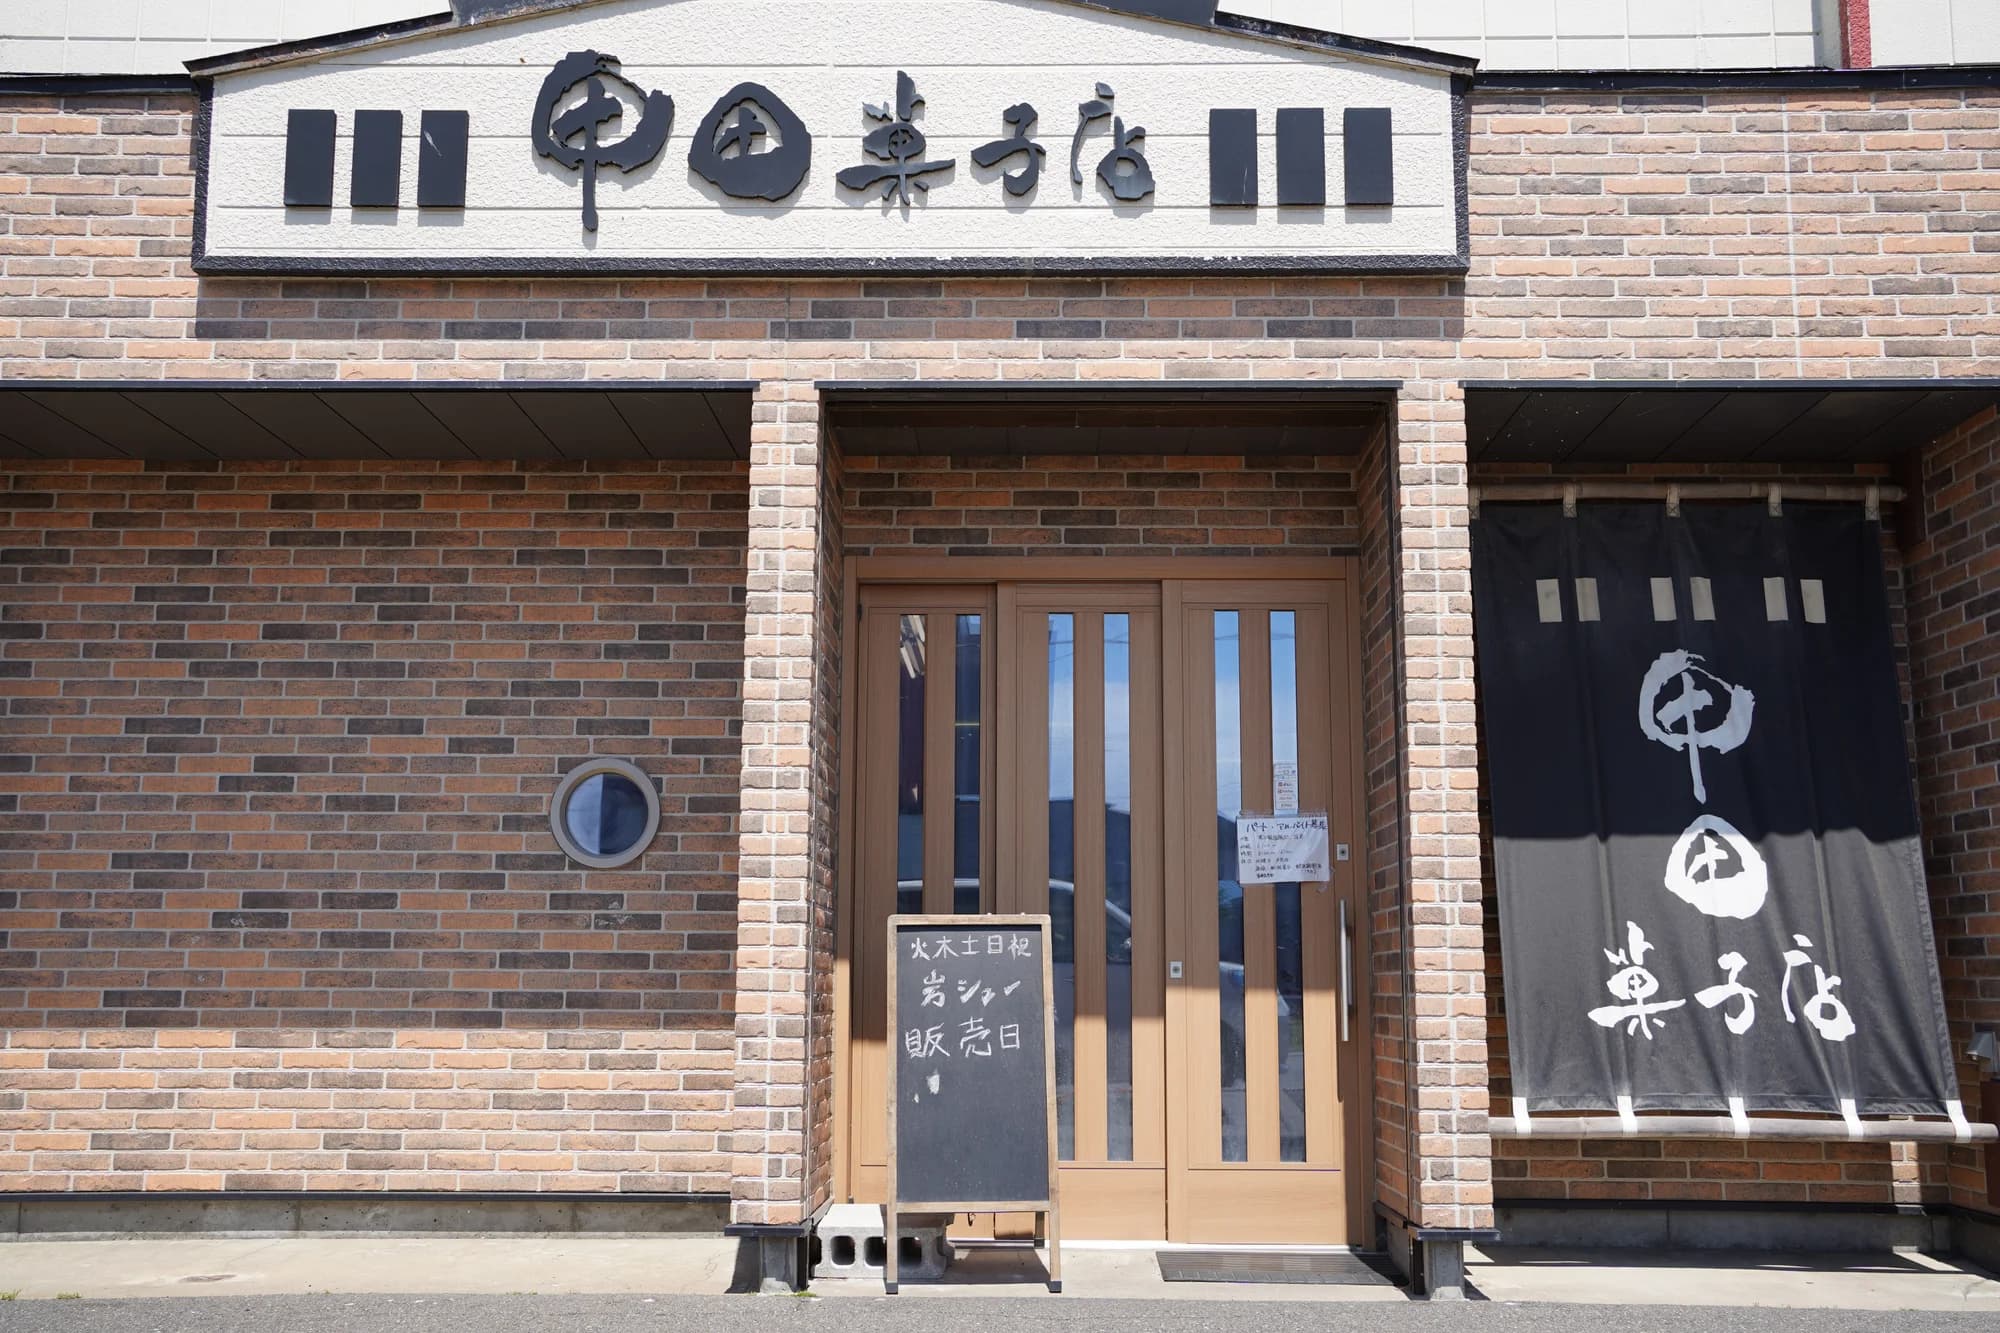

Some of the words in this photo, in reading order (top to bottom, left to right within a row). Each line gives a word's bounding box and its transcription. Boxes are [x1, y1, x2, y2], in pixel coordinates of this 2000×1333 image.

[532, 49, 1155, 231] 甲田菓子店
[1639, 649, 1768, 919] 甲田
[910, 933, 1032, 960] 火木土日祝
[1588, 921, 1855, 1041] 菓子店
[905, 1016, 1020, 1058] 販売日
